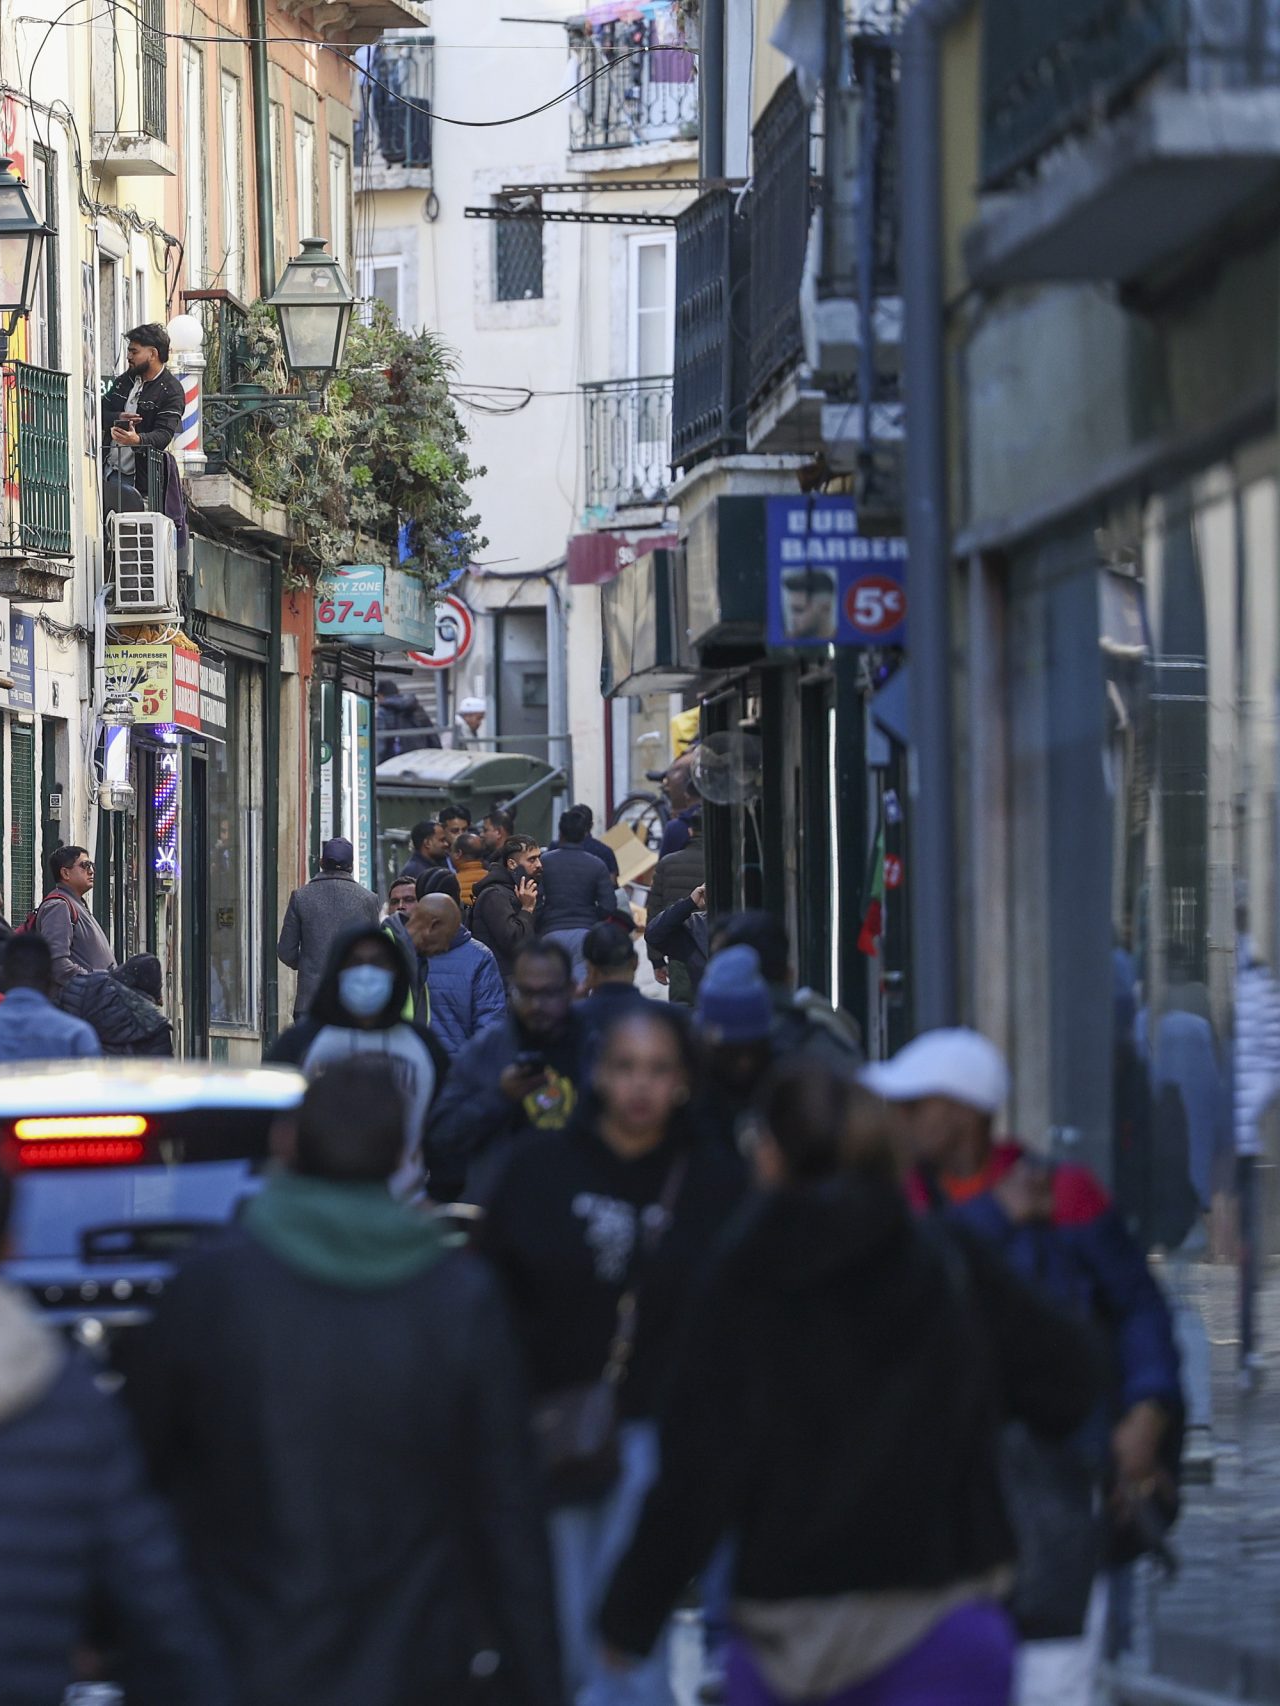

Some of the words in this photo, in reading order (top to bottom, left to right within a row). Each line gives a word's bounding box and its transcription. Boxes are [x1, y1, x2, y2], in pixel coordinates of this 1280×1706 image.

[352, 582, 381, 591] ZONE
[318, 600, 383, 623] 67-A
[142, 689, 168, 716] 5€
[357, 767, 367, 822] STORE
